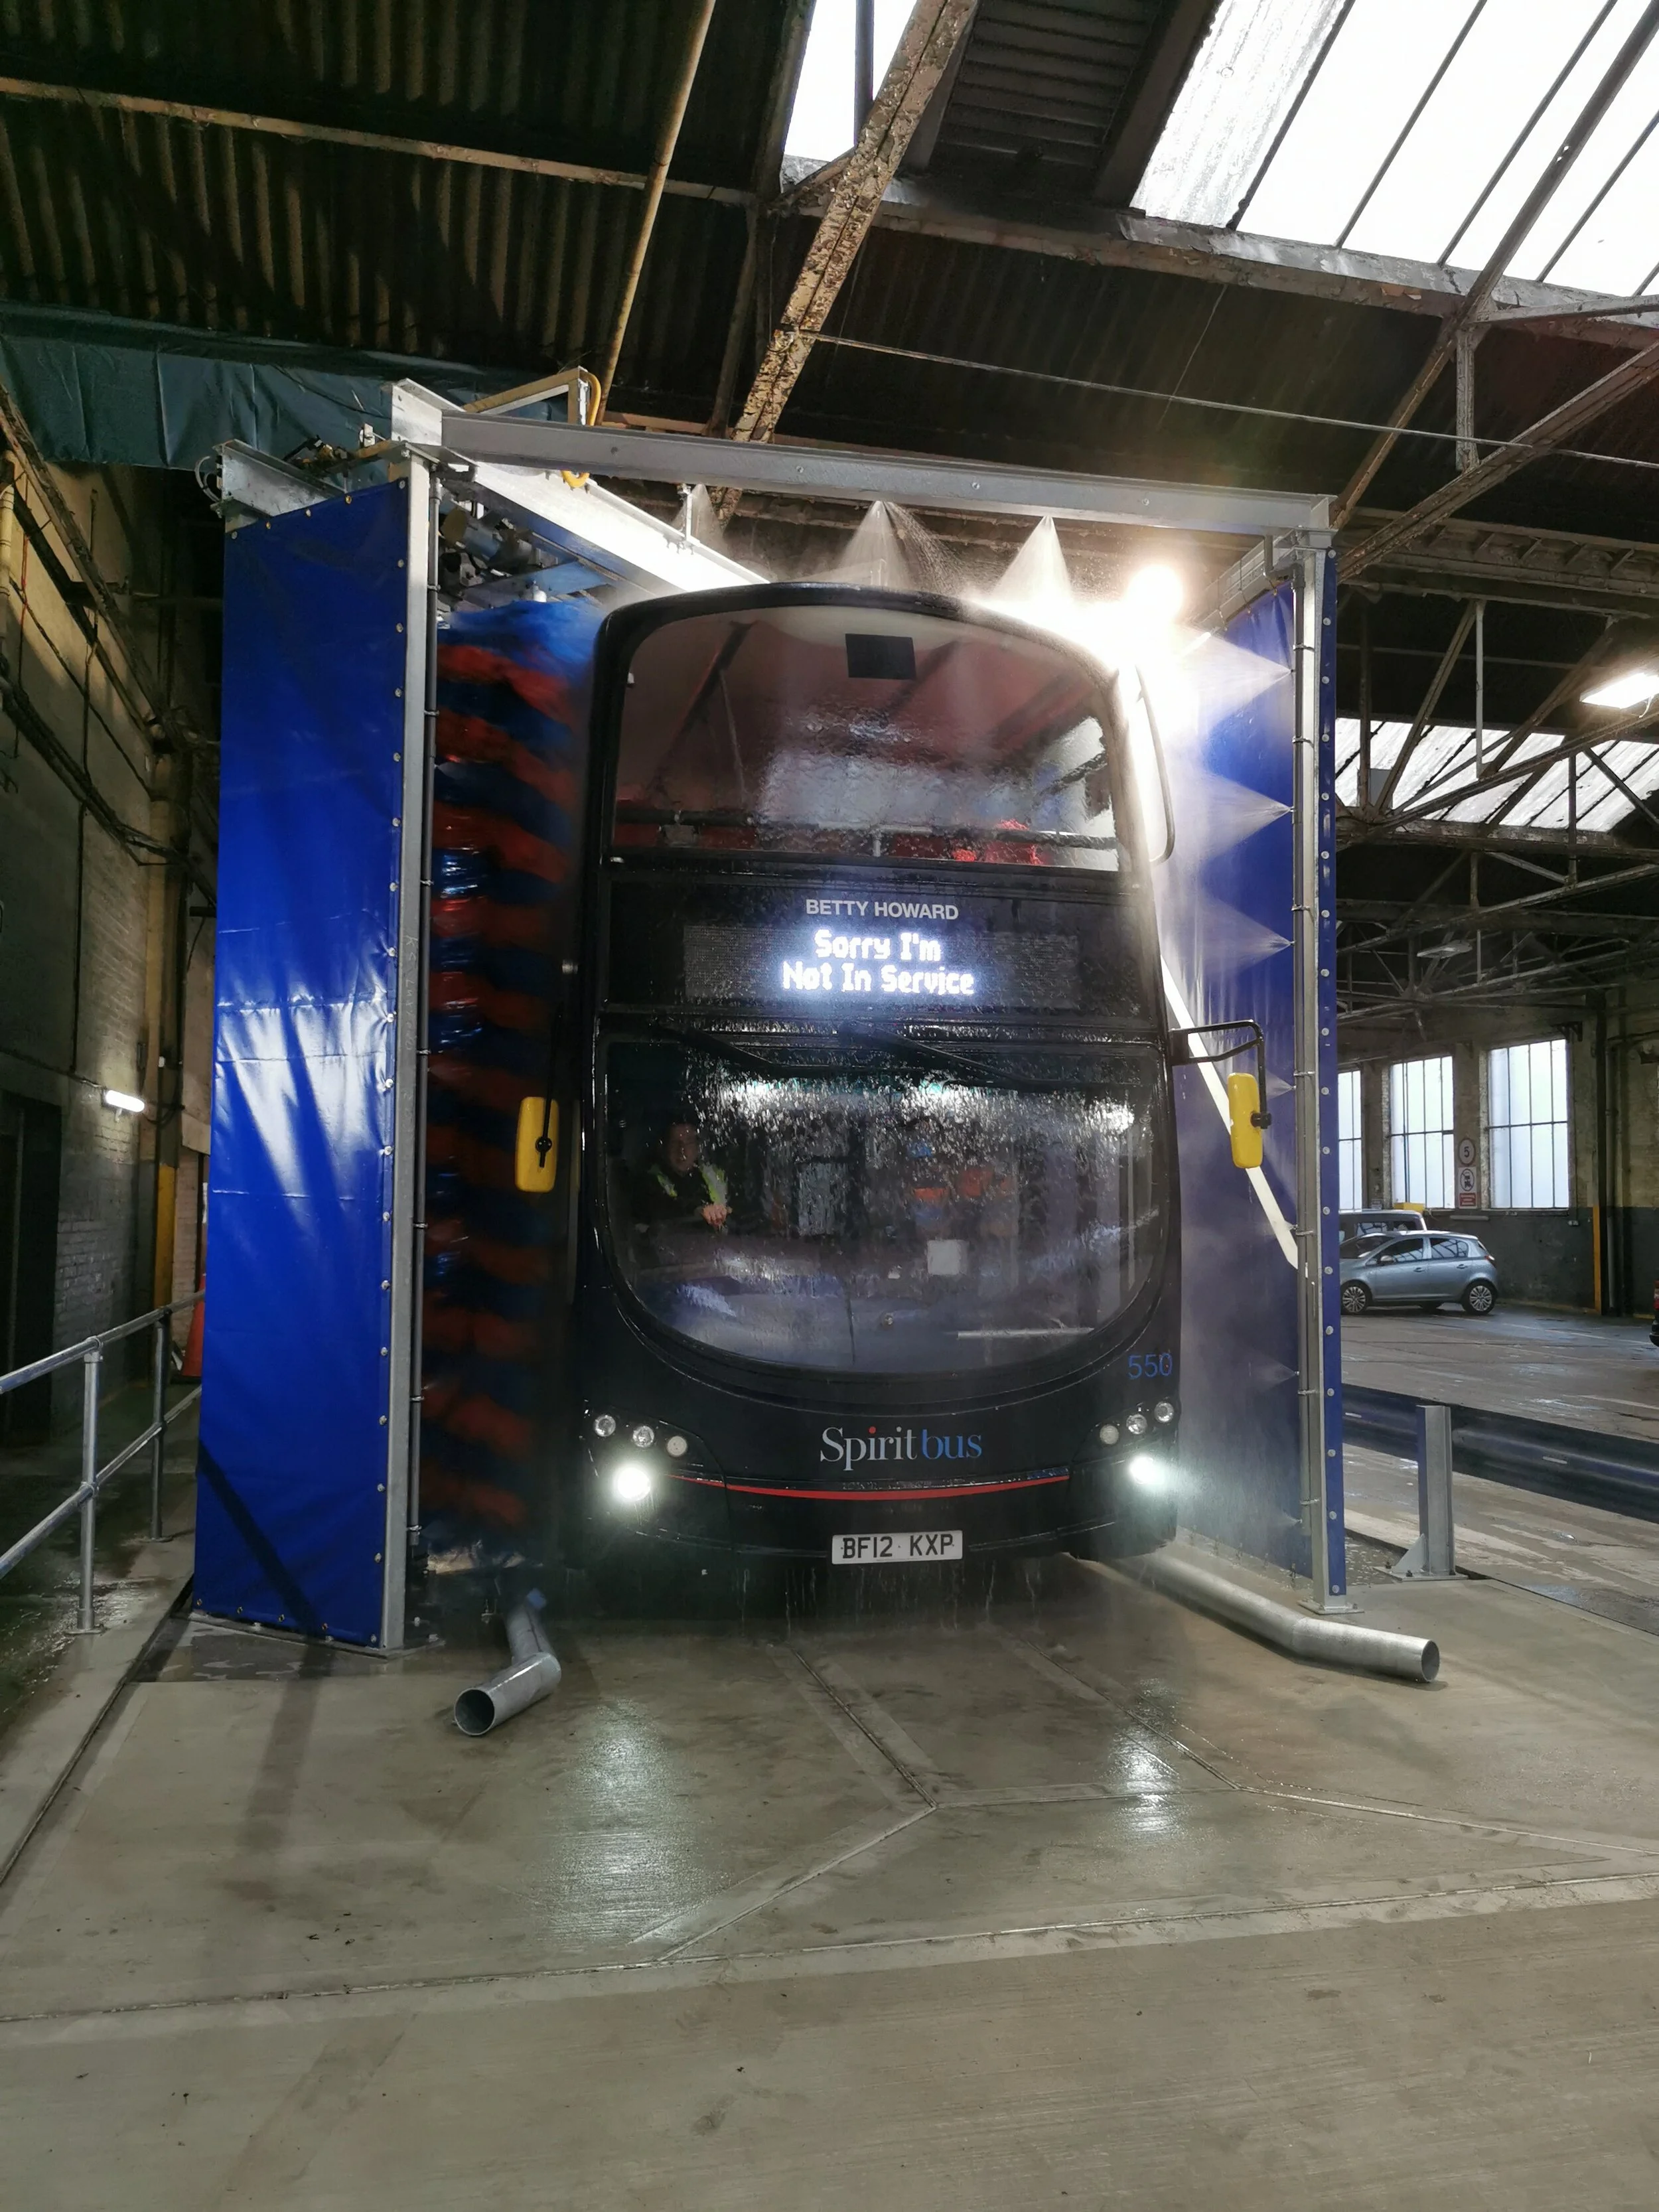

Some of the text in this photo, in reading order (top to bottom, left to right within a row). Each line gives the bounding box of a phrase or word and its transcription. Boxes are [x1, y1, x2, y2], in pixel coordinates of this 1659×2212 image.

[806, 899, 959, 920] BETTY HOWARD
[814, 928, 941, 962] Sorry I'm
[782, 960, 975, 995] Not In Service
[1464, 1146, 1470, 1157] 5
[1128, 1353, 1173, 1379] 550
[842, 1533, 954, 1559] BF12 KXP
